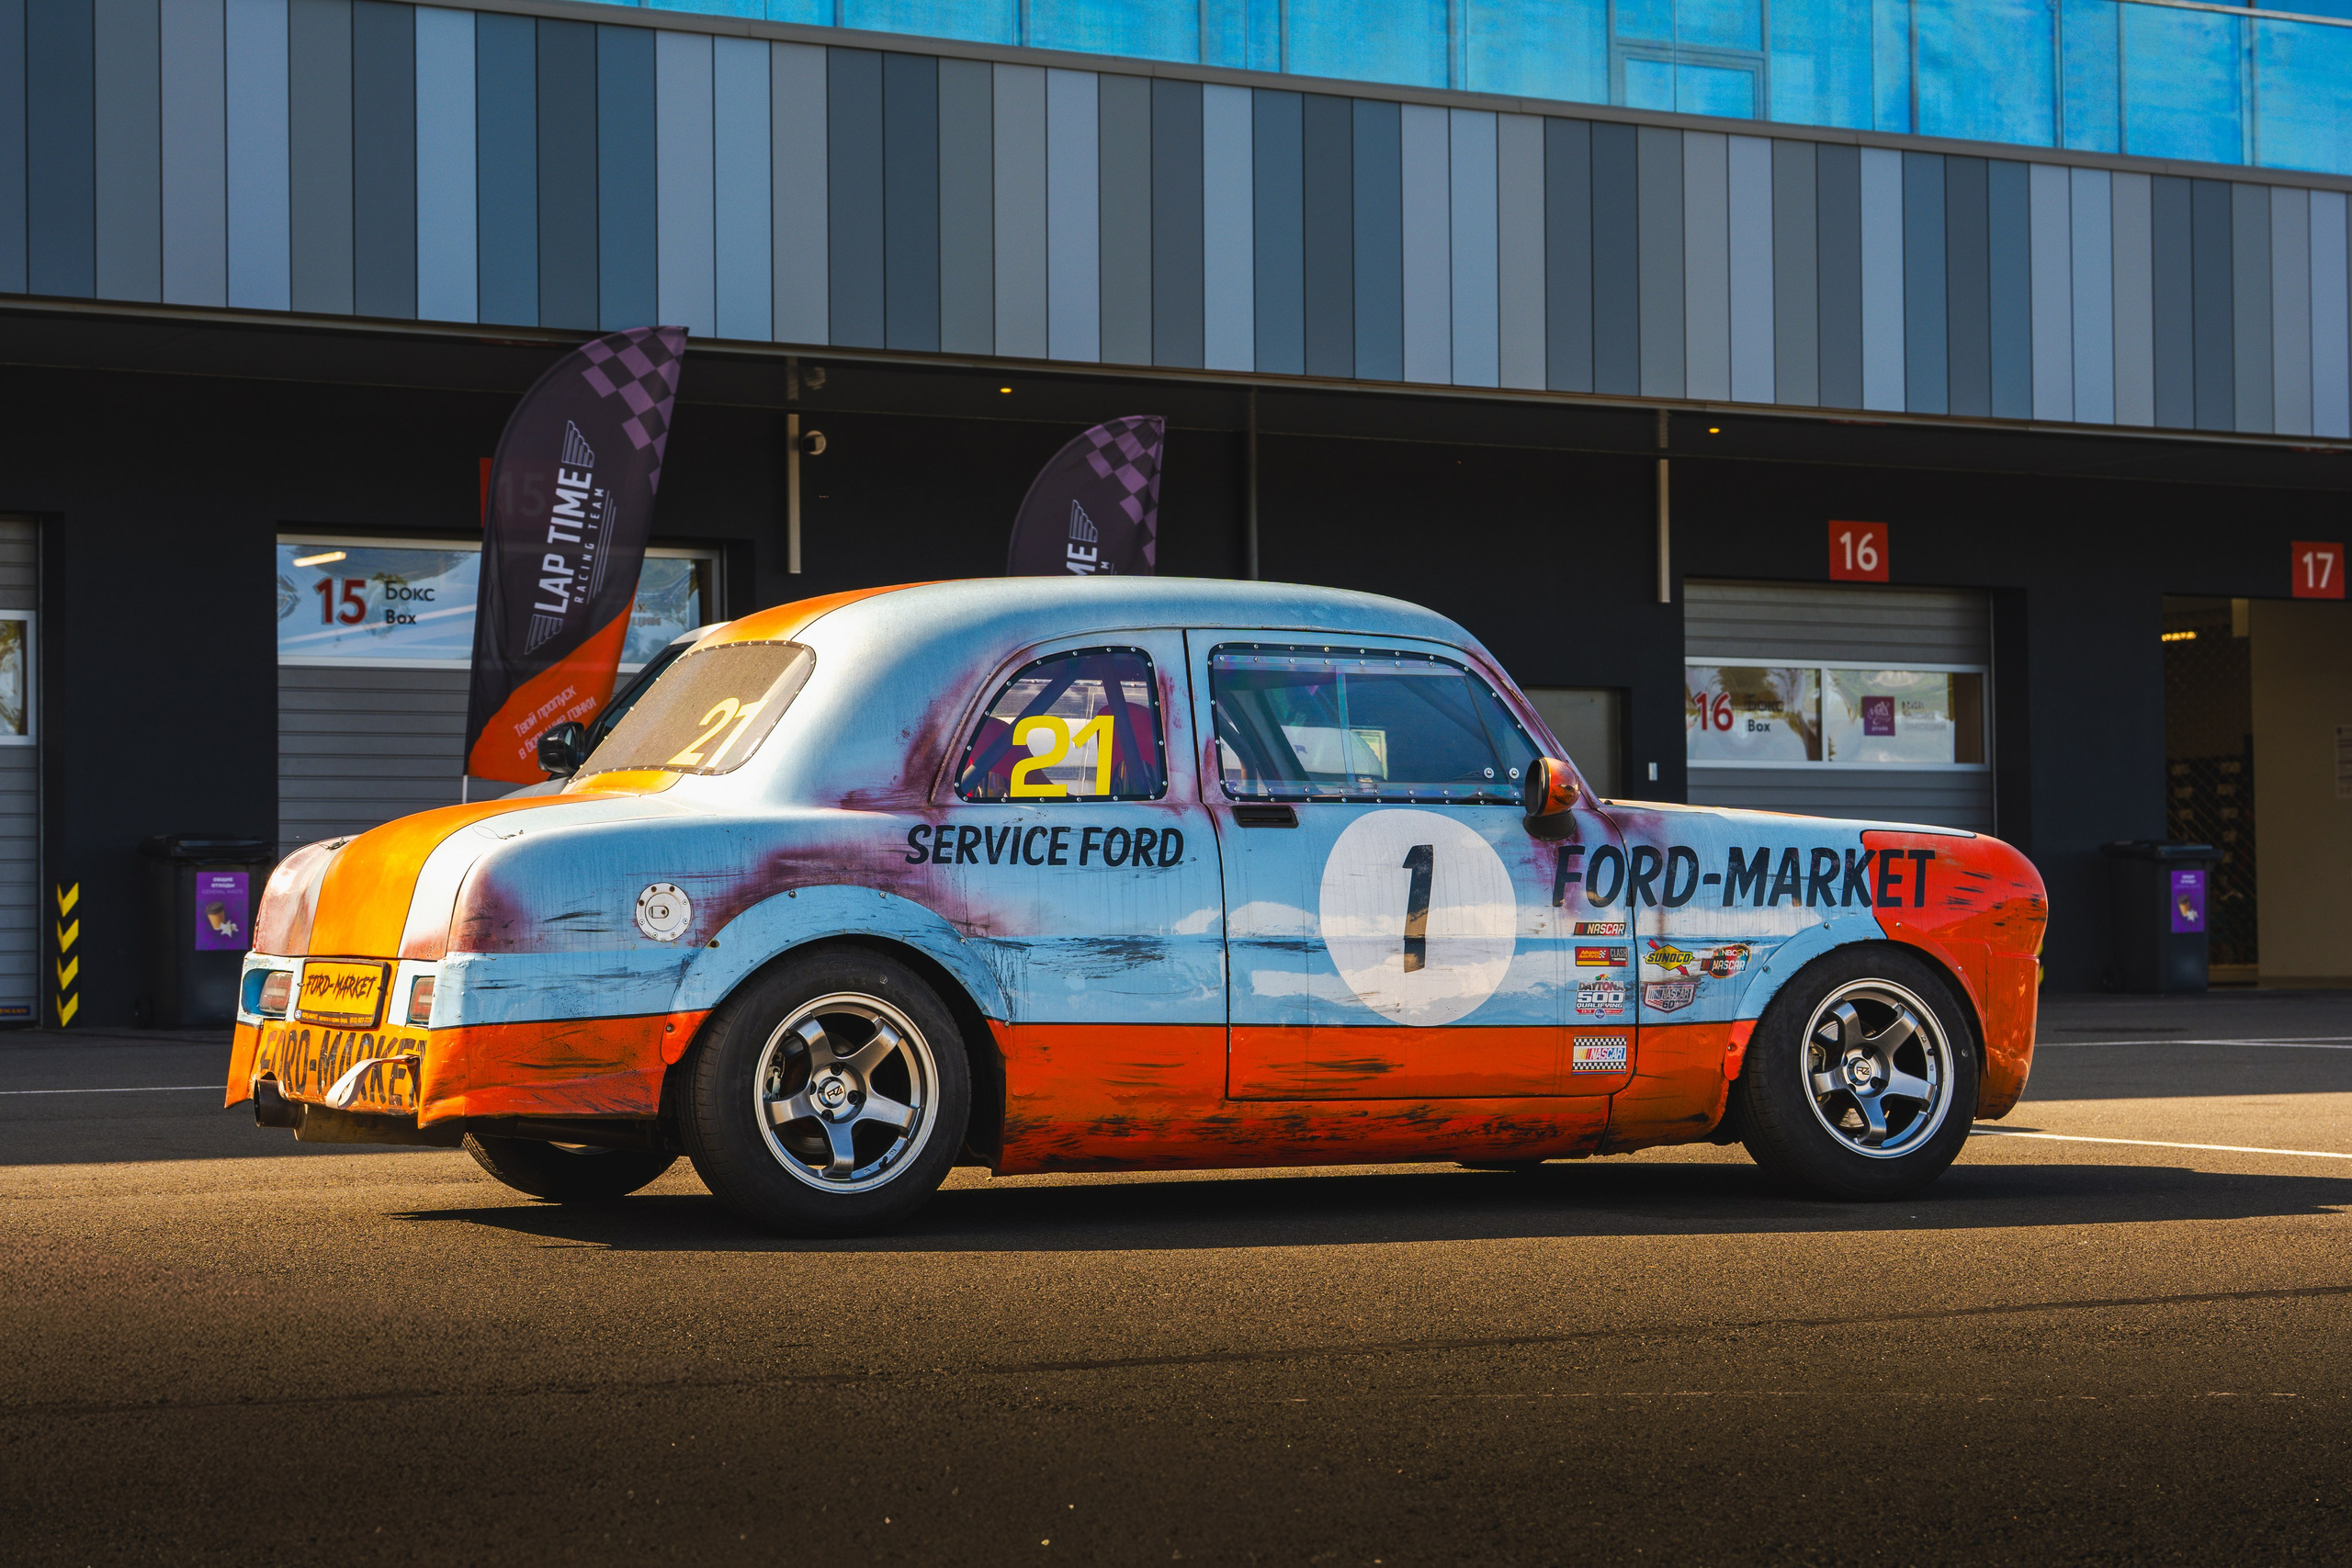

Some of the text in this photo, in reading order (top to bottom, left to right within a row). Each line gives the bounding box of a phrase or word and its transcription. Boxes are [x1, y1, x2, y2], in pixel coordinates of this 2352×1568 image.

[534, 468, 593, 614] LAP TIME
[574, 488, 605, 604] RACING TEAM
[1839, 531, 1878, 571] 16
[2302, 551, 2335, 589] 17
[313, 577, 367, 626] 15
[385, 581, 435, 602] Бокс
[385, 609, 416, 625] Box
[514, 684, 578, 738] Твой пропуск
[1692, 691, 1735, 732] 16
[1747, 719, 1771, 732] Box
[666, 697, 770, 769] 21
[1010, 715, 1114, 797] 21
[905, 824, 1185, 867] SERVICE FORD
[1552, 843, 1936, 909] FORD-MARKET
[1402, 844, 1434, 974] 1
[1587, 923, 1625, 935] NASCAR
[1610, 948, 1627, 958] CLASH
[1647, 953, 1691, 963] SUNOCO
[1711, 960, 1746, 971] NASCAR
[304, 972, 378, 1002] FORD-MARKET
[1577, 980, 1625, 991] DAYTONA
[1577, 991, 1624, 1003] 500
[1662, 1000, 1675, 1009] 60
[1589, 1047, 1625, 1059] NASCAR
